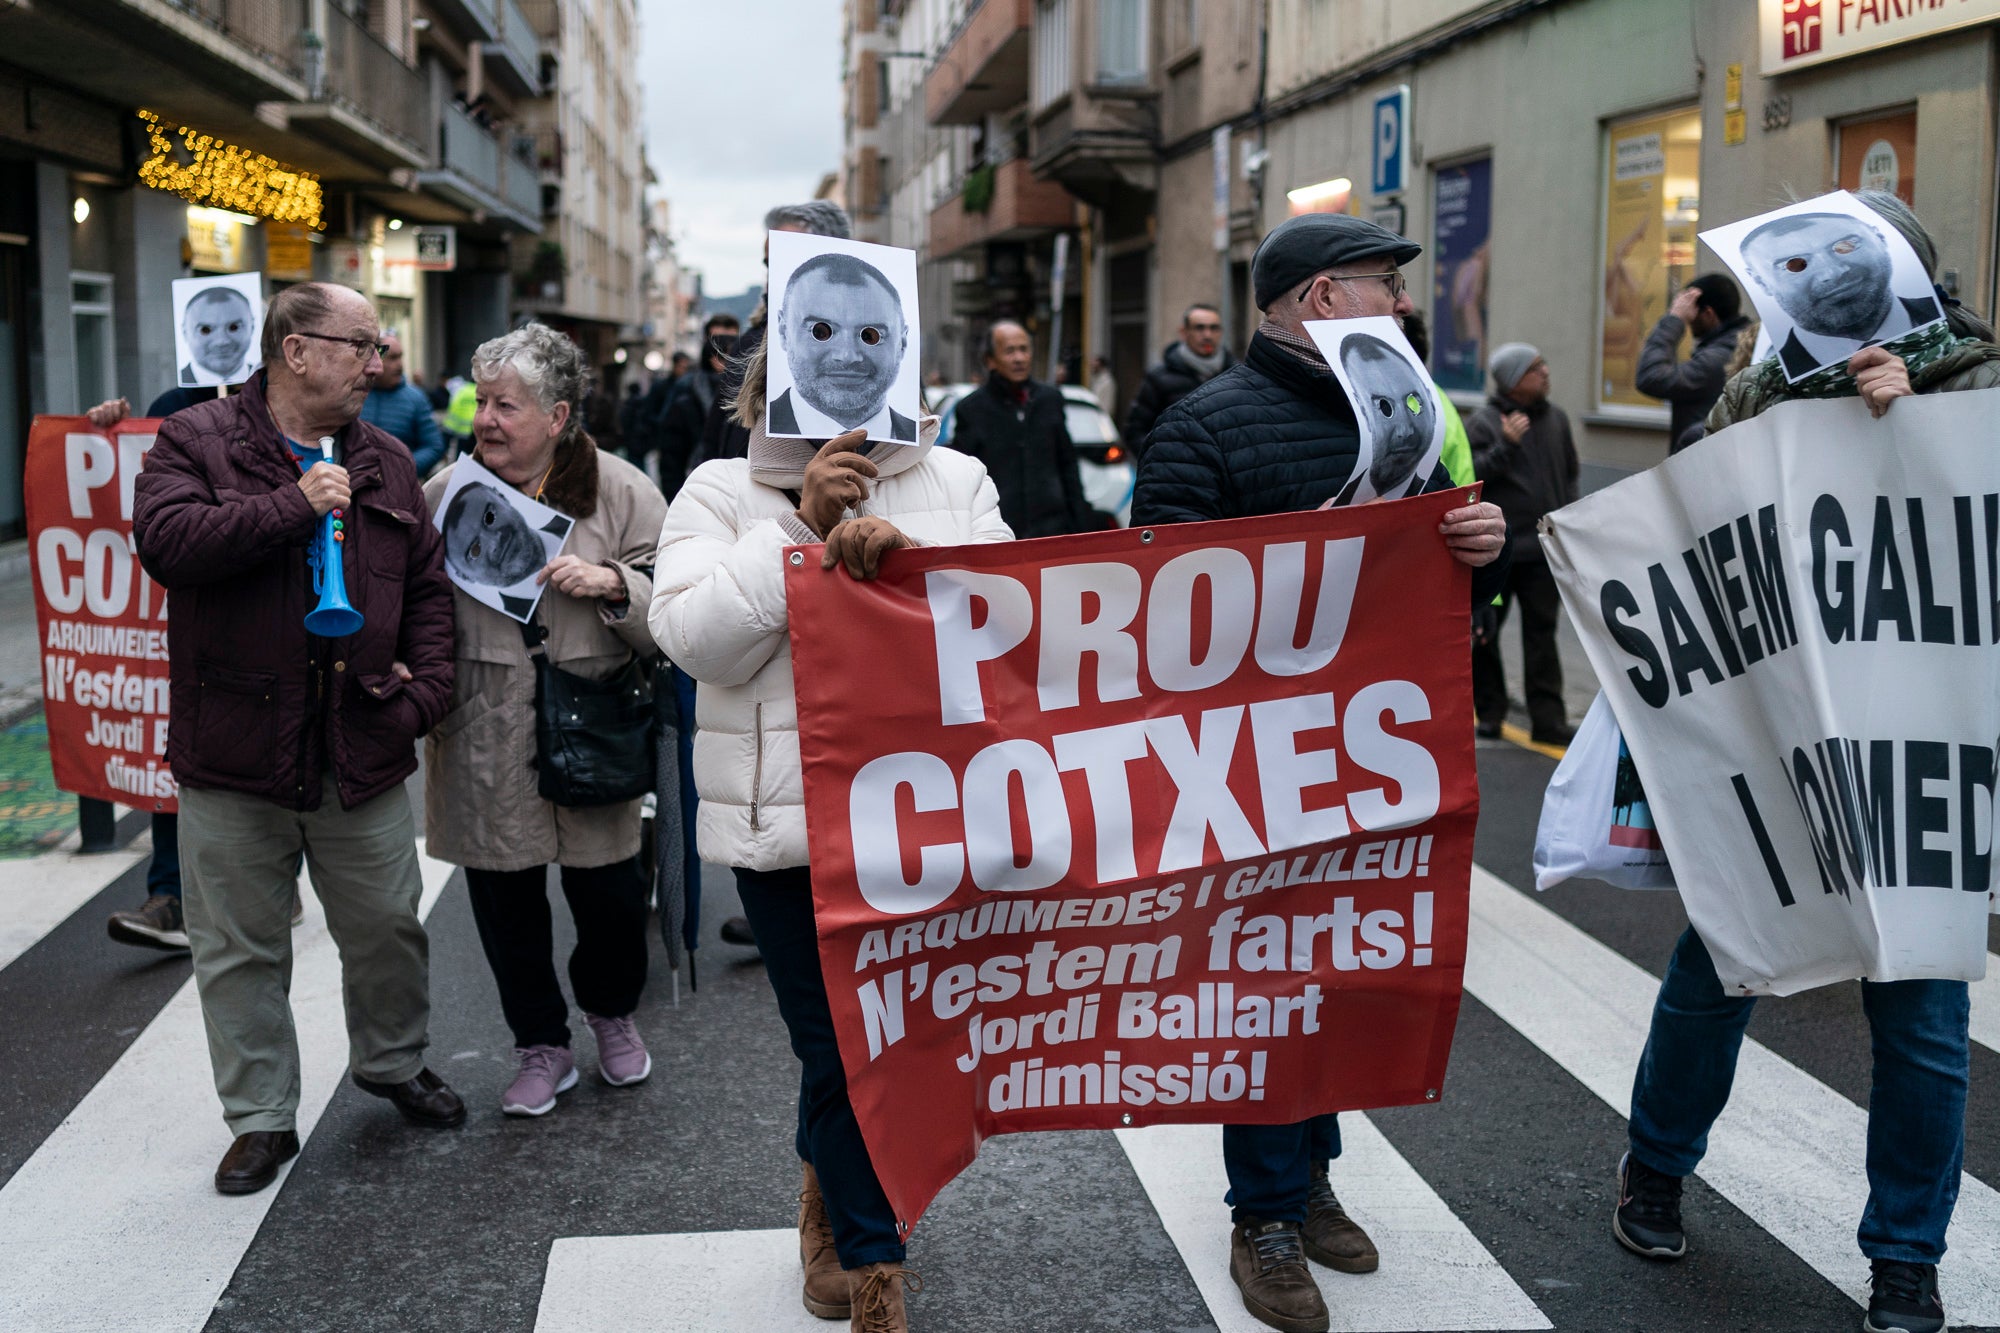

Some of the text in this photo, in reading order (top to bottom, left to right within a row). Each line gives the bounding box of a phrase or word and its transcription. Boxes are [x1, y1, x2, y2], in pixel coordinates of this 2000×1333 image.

[1377, 103, 1400, 188] P
[925, 535, 1366, 727] PROU
[84, 711, 145, 754] Jordi
[848, 679, 1441, 914] COTXES
[854, 834, 1434, 974] ARQUIMEDES I GALILEU!
[1730, 773, 1797, 908] I
[858, 891, 1435, 1062] N'estem farts!
[955, 982, 1323, 1073] Jordi Ballart
[988, 1050, 1268, 1113] dimissió!
